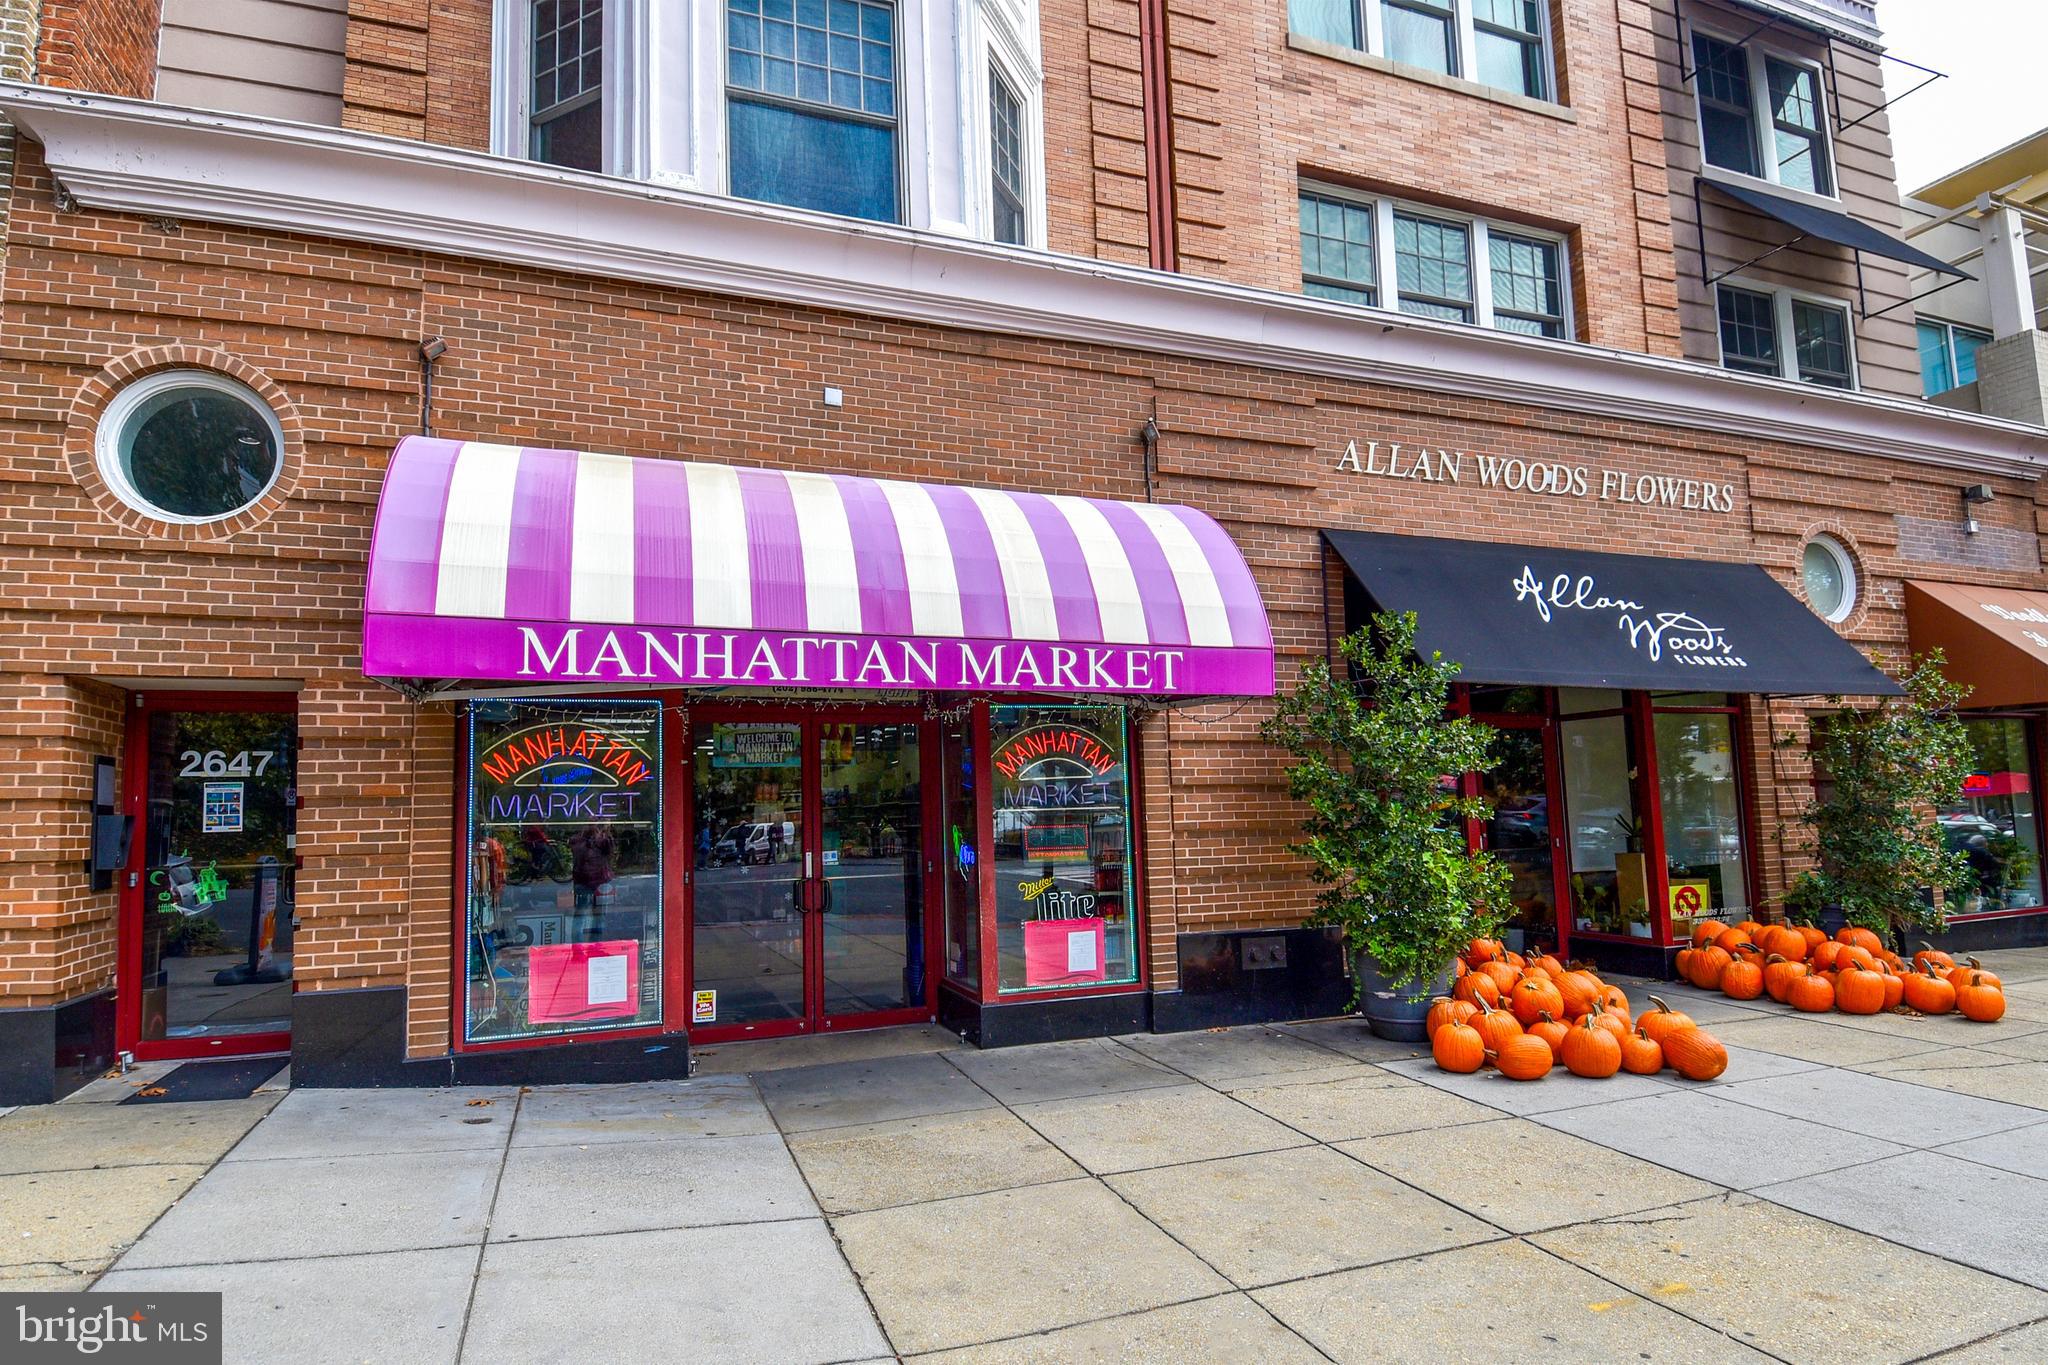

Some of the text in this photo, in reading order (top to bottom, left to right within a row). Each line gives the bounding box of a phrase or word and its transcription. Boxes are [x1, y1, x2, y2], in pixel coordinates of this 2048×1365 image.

[1336, 439, 1734, 513] ALLAN WOODS FLOWERS
[1513, 565, 1644, 623] Allan
[1619, 612, 1733, 661] Woods
[516, 627, 1184, 690] MANHATTAN MARKET
[1673, 654, 1748, 667] FLOWERS
[736, 742, 793, 754] MANHATTAN
[737, 732, 792, 743] WELCOME TO
[180, 750, 274, 777] 2647
[482, 726, 650, 786] MANHATTAN
[746, 752, 784, 763] MARKET
[996, 730, 1116, 779] MANHATTAN
[490, 792, 641, 820] MARKET
[1003, 782, 1110, 806] MARKET
[1018, 876, 1056, 899] Miller
